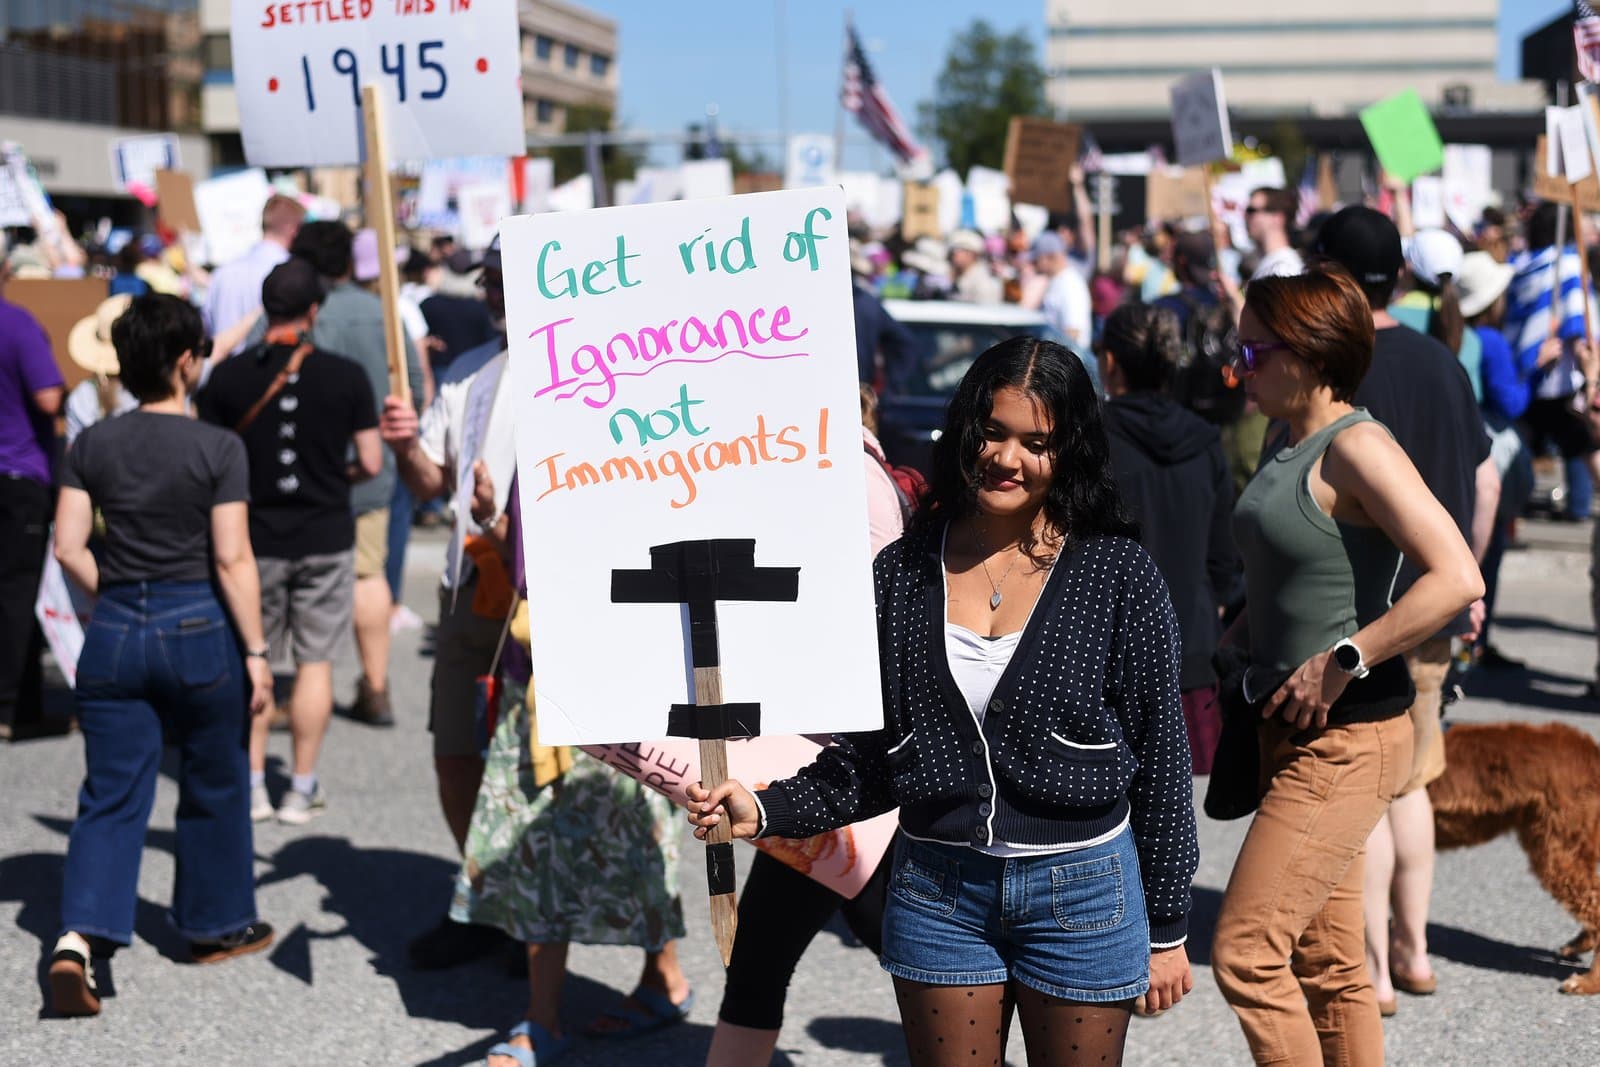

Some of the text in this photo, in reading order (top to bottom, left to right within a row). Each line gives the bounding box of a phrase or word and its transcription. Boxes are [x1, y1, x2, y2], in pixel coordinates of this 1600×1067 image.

[261, 0, 374, 28] SETTLED
[302, 41, 448, 112] 1945
[536, 207, 833, 300] Get rid of
[529, 305, 809, 409] Ignorance
[609, 383, 710, 446] not
[534, 407, 833, 509] Immigrants!
